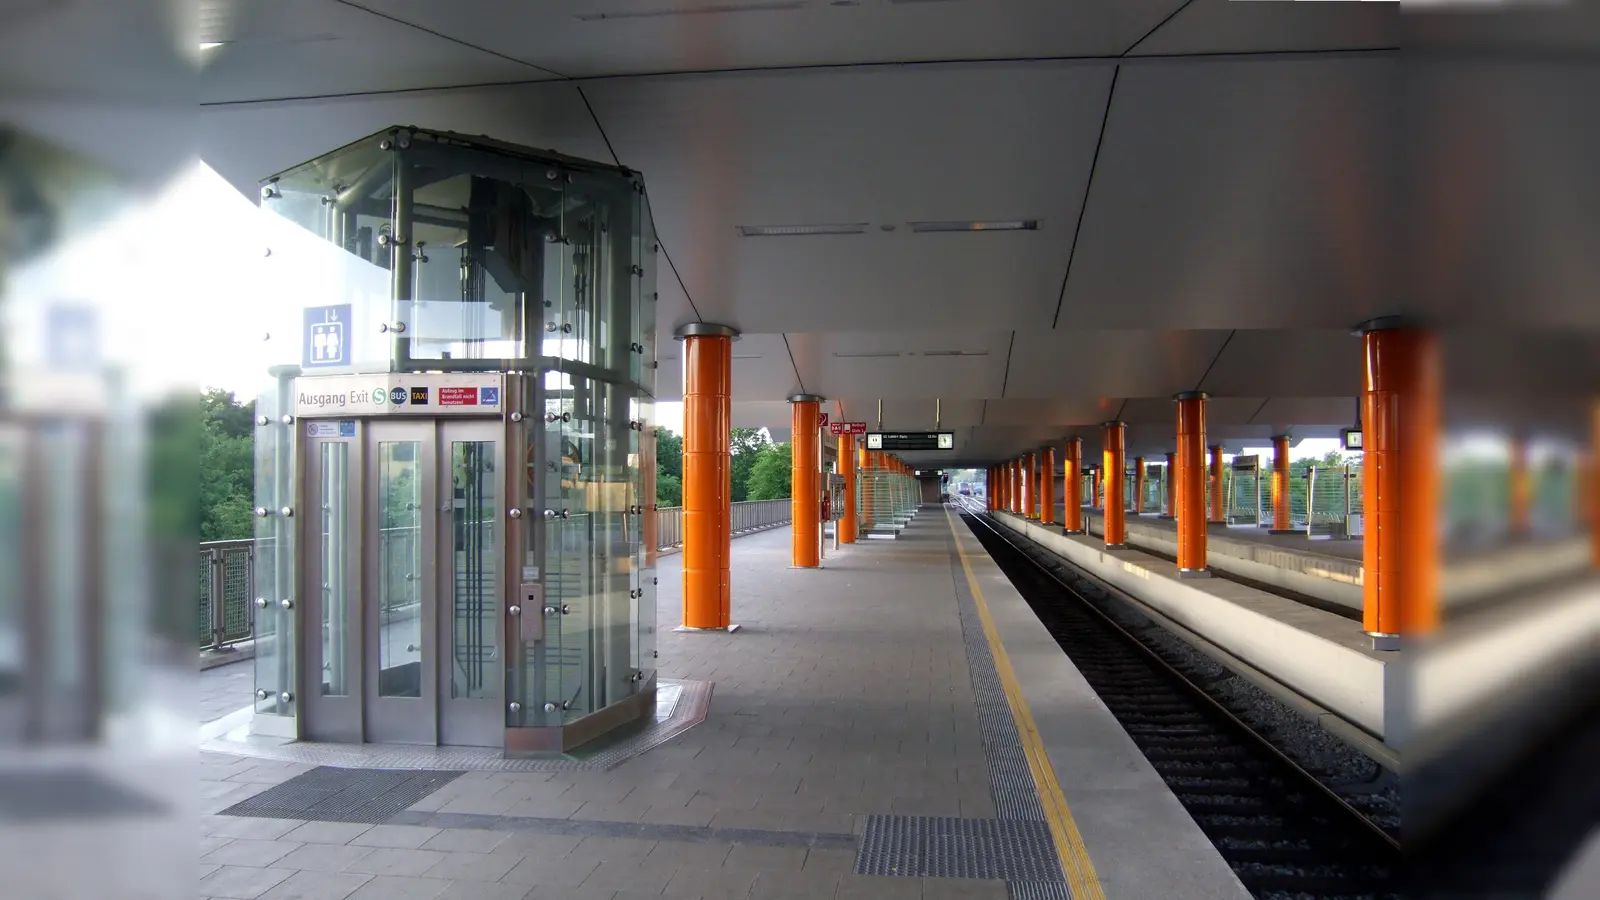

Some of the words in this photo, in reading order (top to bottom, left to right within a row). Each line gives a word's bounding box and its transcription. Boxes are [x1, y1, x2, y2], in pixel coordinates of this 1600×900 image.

[299, 392, 346, 407] Ausgang
[350, 390, 369, 404] Exit
[374, 388, 385, 404] S
[390, 391, 407, 401] BUS
[412, 392, 428, 400] TAXI
